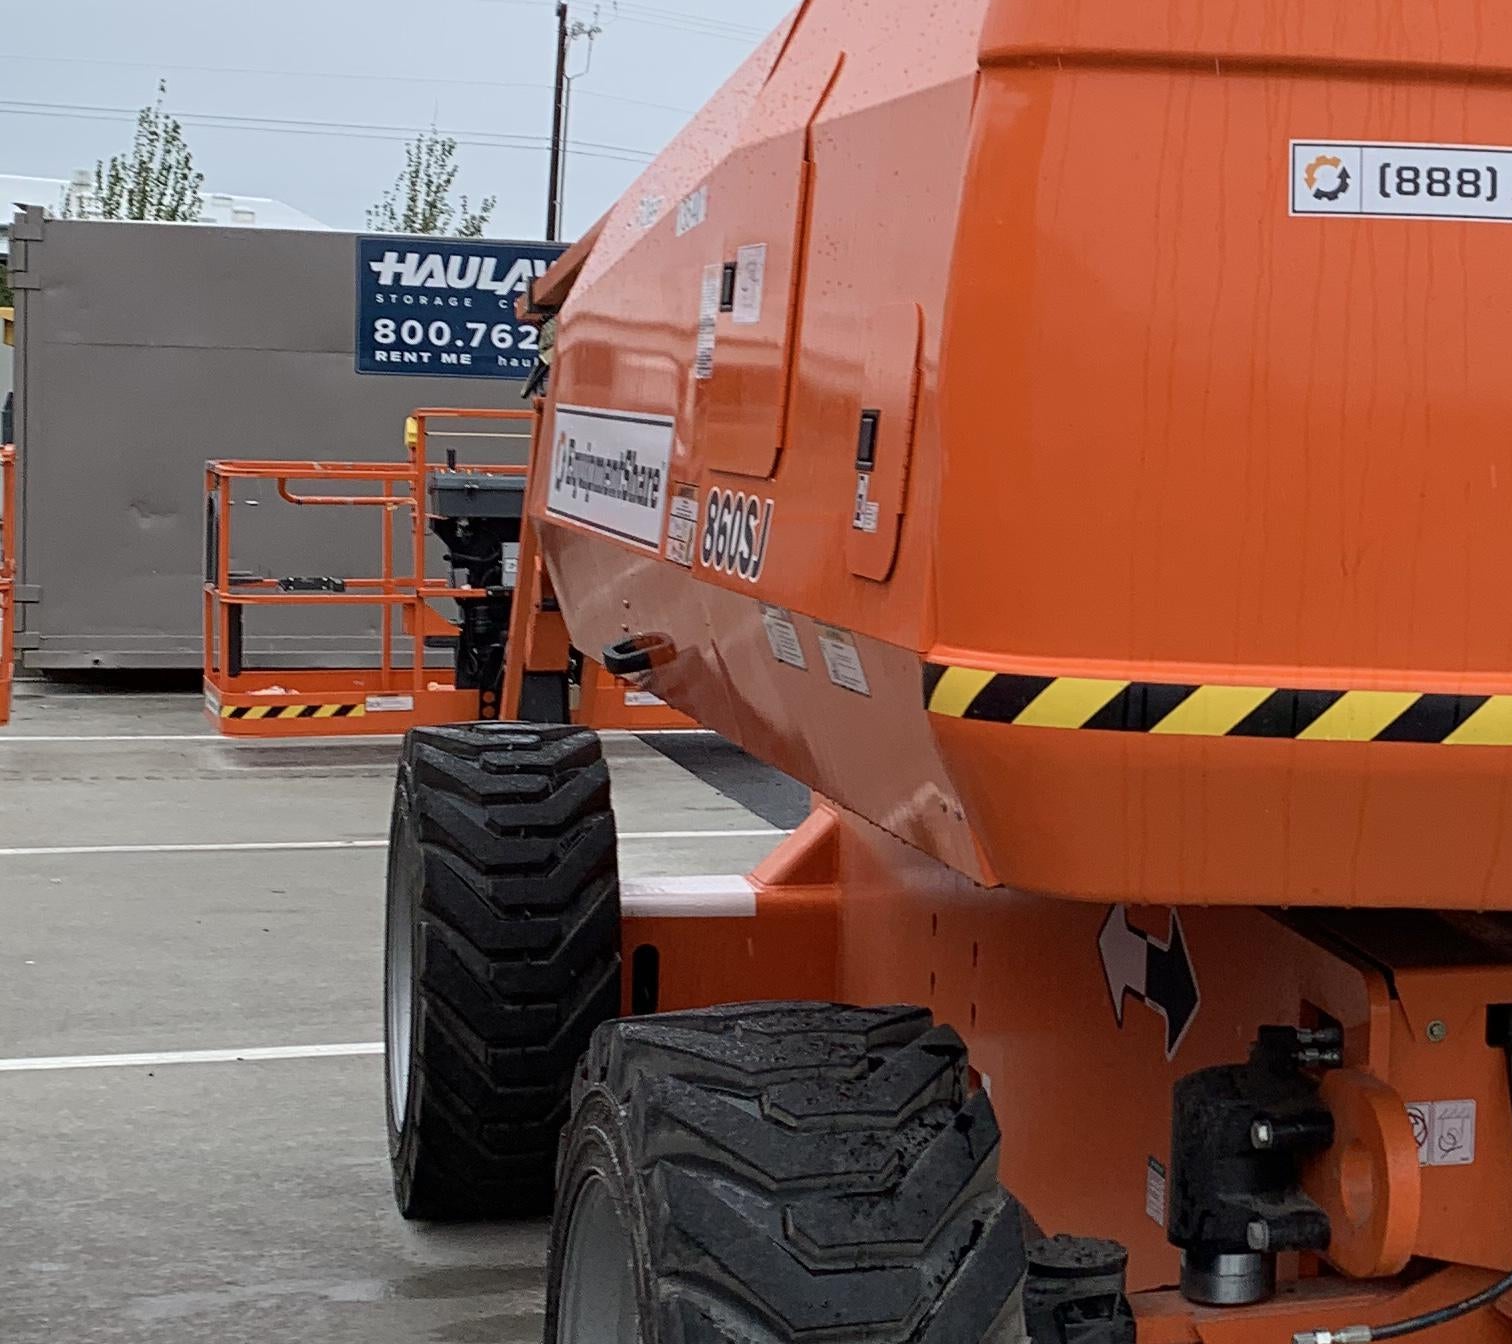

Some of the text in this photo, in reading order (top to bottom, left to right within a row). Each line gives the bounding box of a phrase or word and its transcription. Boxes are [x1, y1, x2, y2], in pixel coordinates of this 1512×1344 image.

[1378, 162, 1498, 202] (888)
[375, 293, 473, 307] STORAGE
[374, 350, 432, 363] RENT
[440, 353, 472, 365] ME
[702, 488, 773, 581] 860SJ
